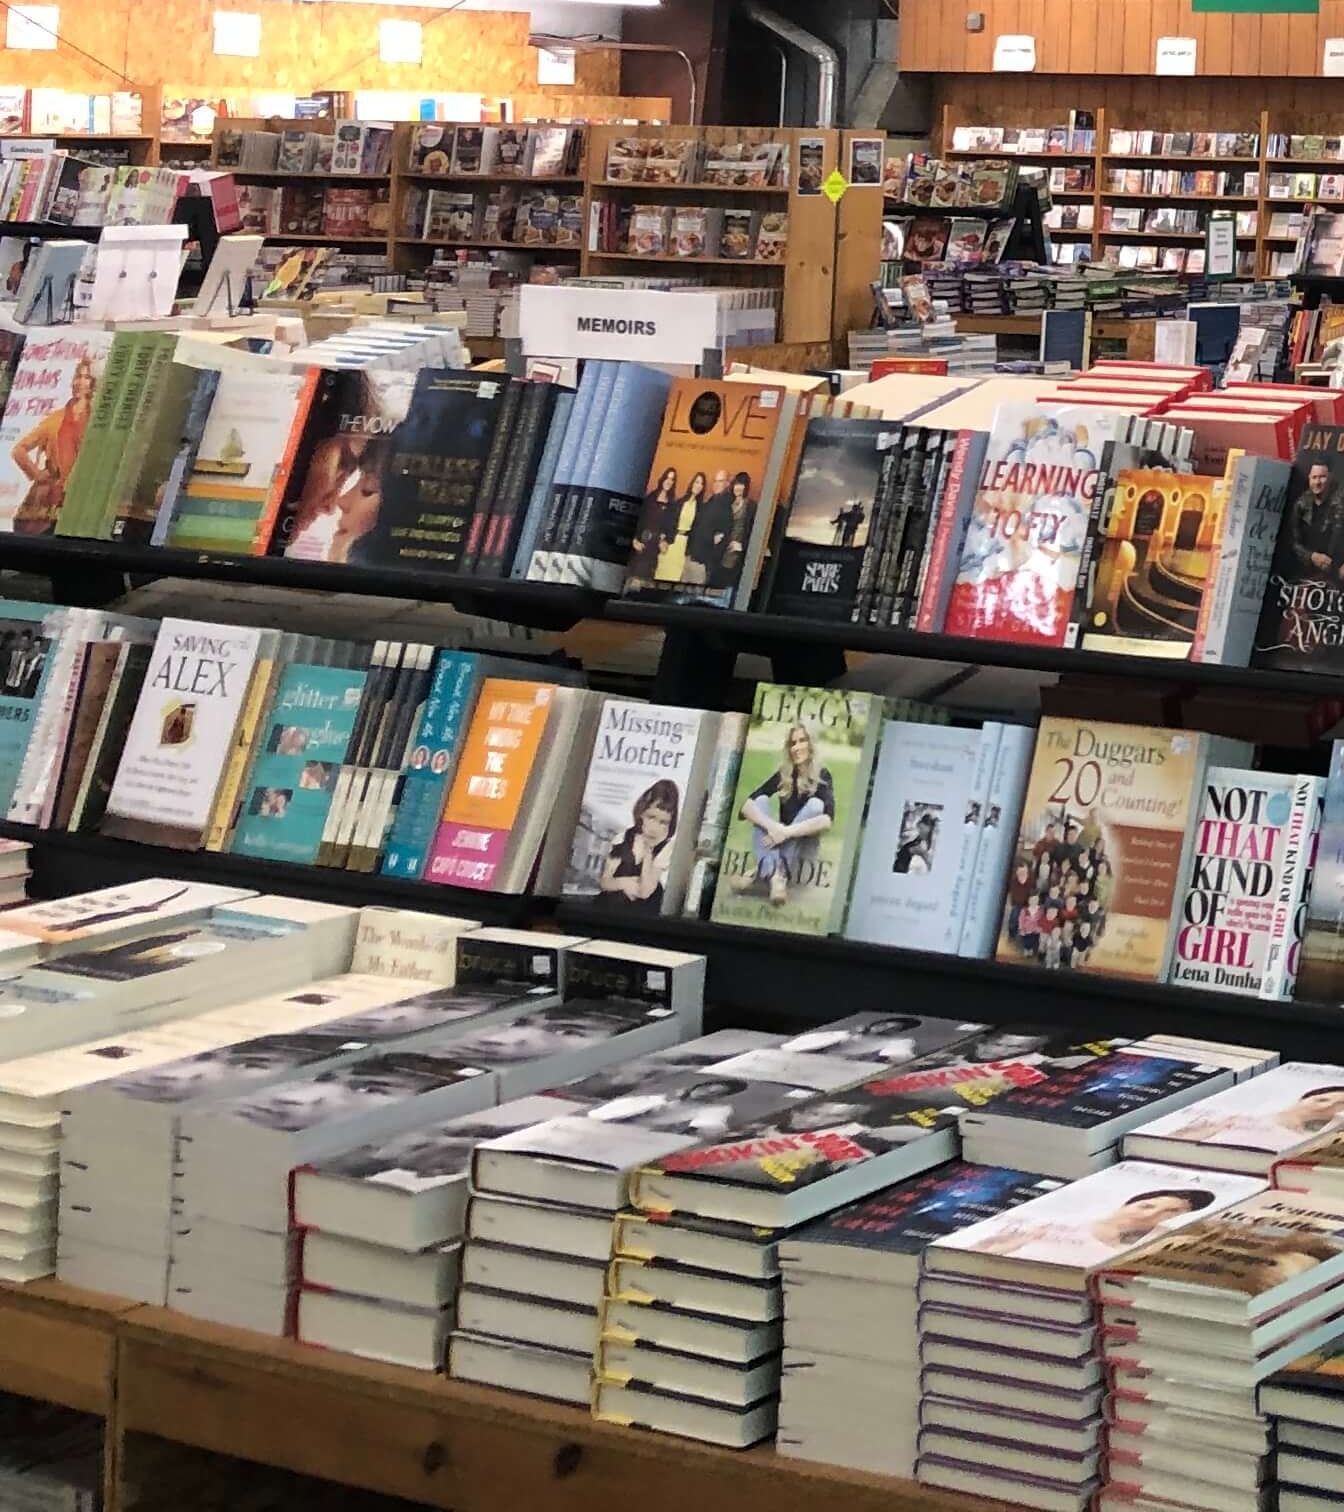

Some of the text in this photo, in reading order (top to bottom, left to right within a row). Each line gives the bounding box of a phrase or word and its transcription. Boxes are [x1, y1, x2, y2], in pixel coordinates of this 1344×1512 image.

[576, 316, 657, 336] MEMOIRS
[669, 389, 768, 440] LOVE
[980, 459, 1099, 501] LEARNING
[173, 633, 231, 657] SAVING
[151, 654, 239, 698] ALEX
[605, 706, 684, 745] Missing
[597, 734, 685, 771] Mother
[1045, 727, 1166, 769] The Duggars
[1047, 757, 1135, 807] 20 and
[1204, 785, 1268, 825] NOT
[1198, 819, 1281, 862] THAT
[1272, 781, 1310, 939] NOT THAT KIND OF GIRL
[723, 847, 833, 889] BLONDE
[1190, 854, 1274, 898] KIND
[1183, 888, 1228, 927] OF
[1176, 924, 1254, 969] GIRL
